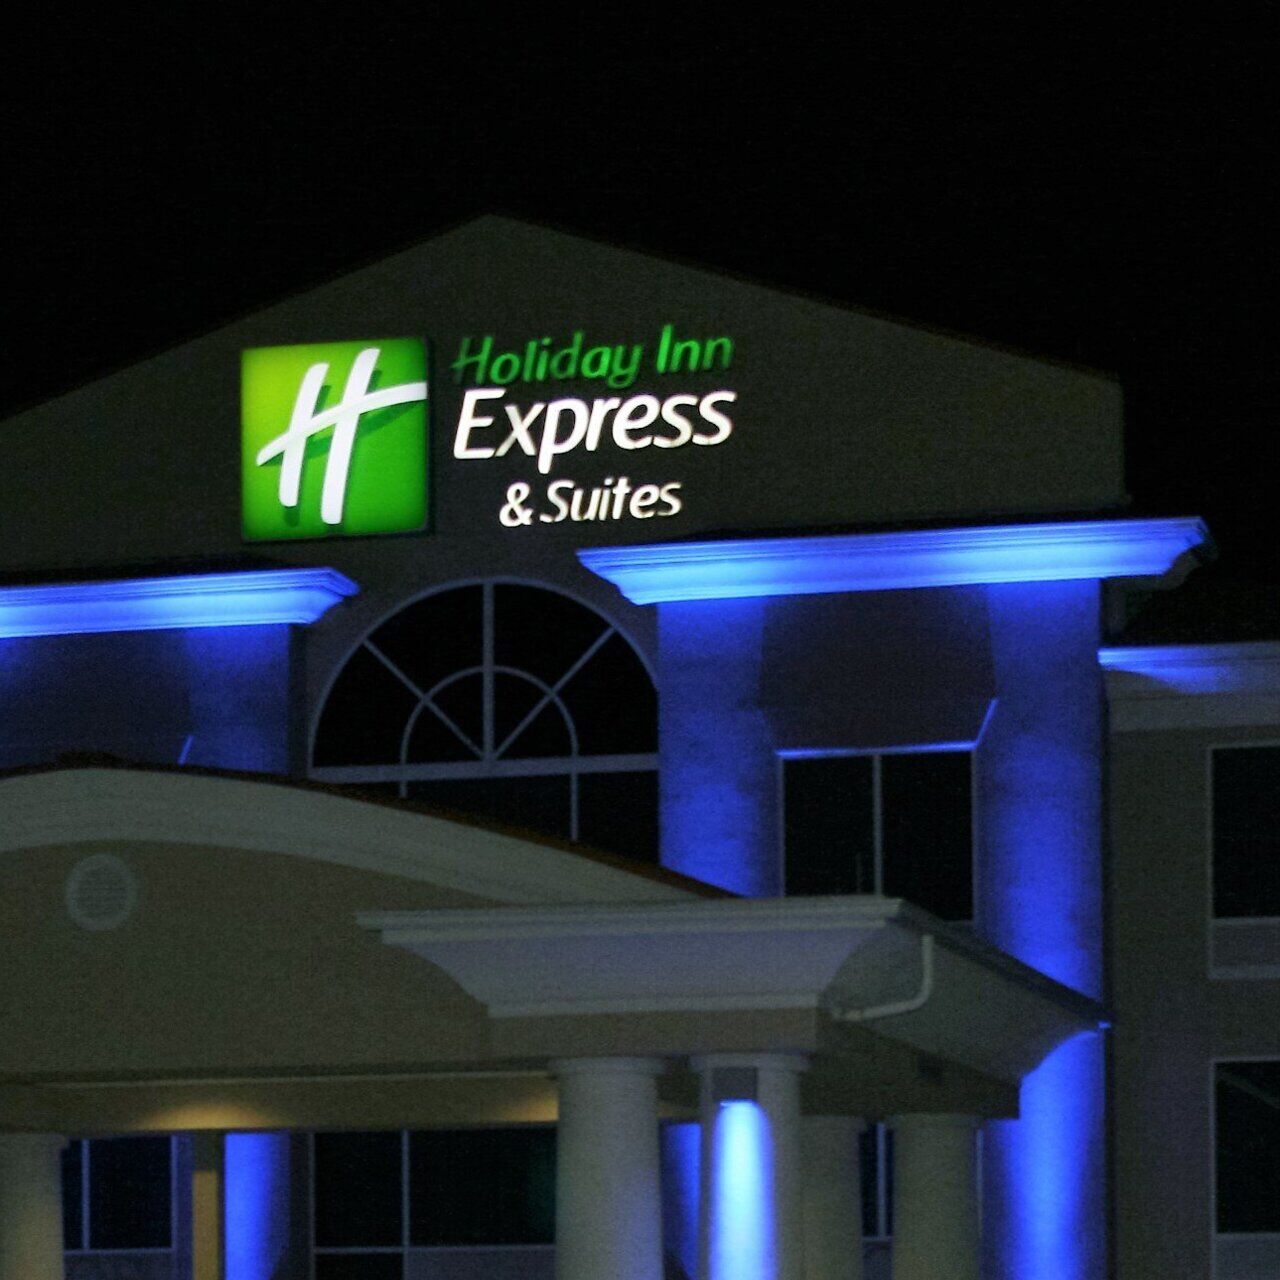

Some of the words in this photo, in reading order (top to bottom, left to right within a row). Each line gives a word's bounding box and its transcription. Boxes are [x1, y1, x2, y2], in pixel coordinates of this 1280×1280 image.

[451, 330, 642, 388] Holiday
[656, 324, 734, 374] Inn
[453, 387, 738, 474] Express
[499, 481, 533, 527] &
[539, 476, 682, 523] Suites
